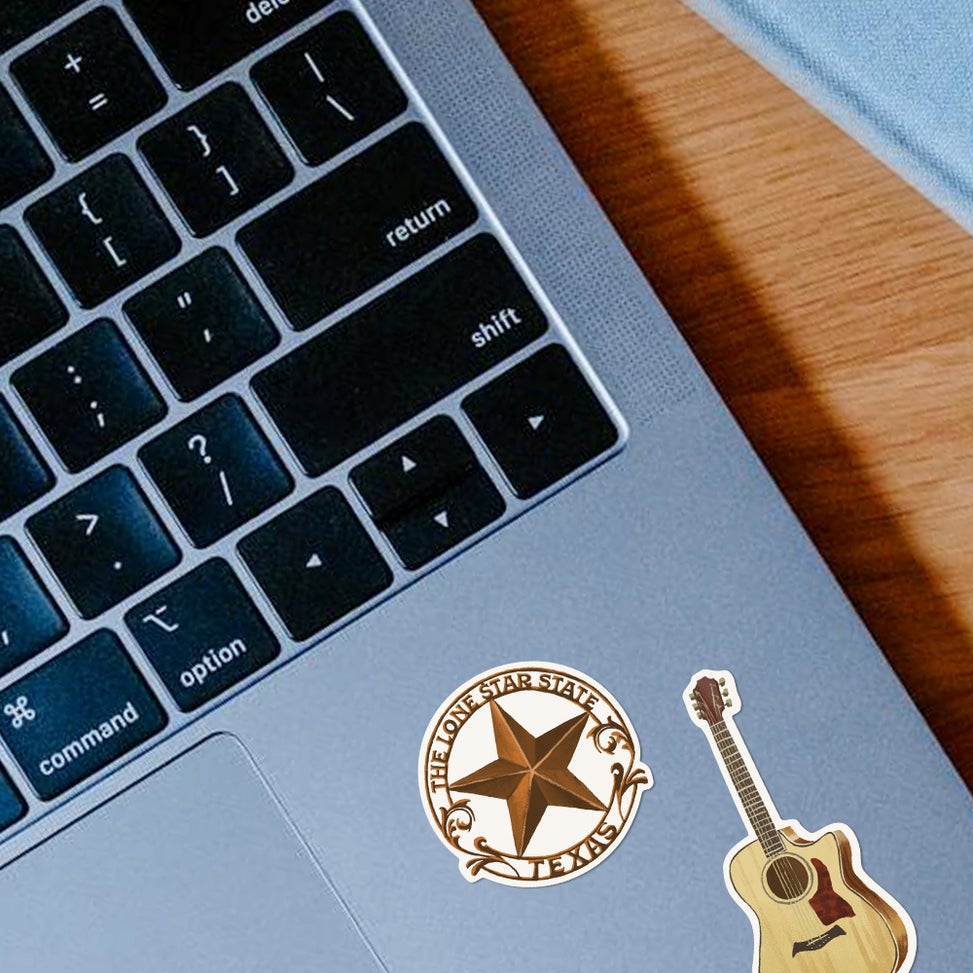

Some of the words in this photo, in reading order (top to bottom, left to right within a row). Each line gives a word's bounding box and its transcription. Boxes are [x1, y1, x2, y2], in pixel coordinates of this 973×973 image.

[246, 0, 290, 23] de
[387, 200, 452, 248] return
[471, 308, 523, 349] shift
[189, 435, 211, 463] ?
[180, 637, 247, 689] option
[479, 673, 532, 701] STAR
[539, 674, 599, 711] STATE
[39, 702, 141, 777] command
[436, 694, 478, 749] LONE
[430, 750, 447, 793] THE
[528, 822, 617, 880] TEXAS
